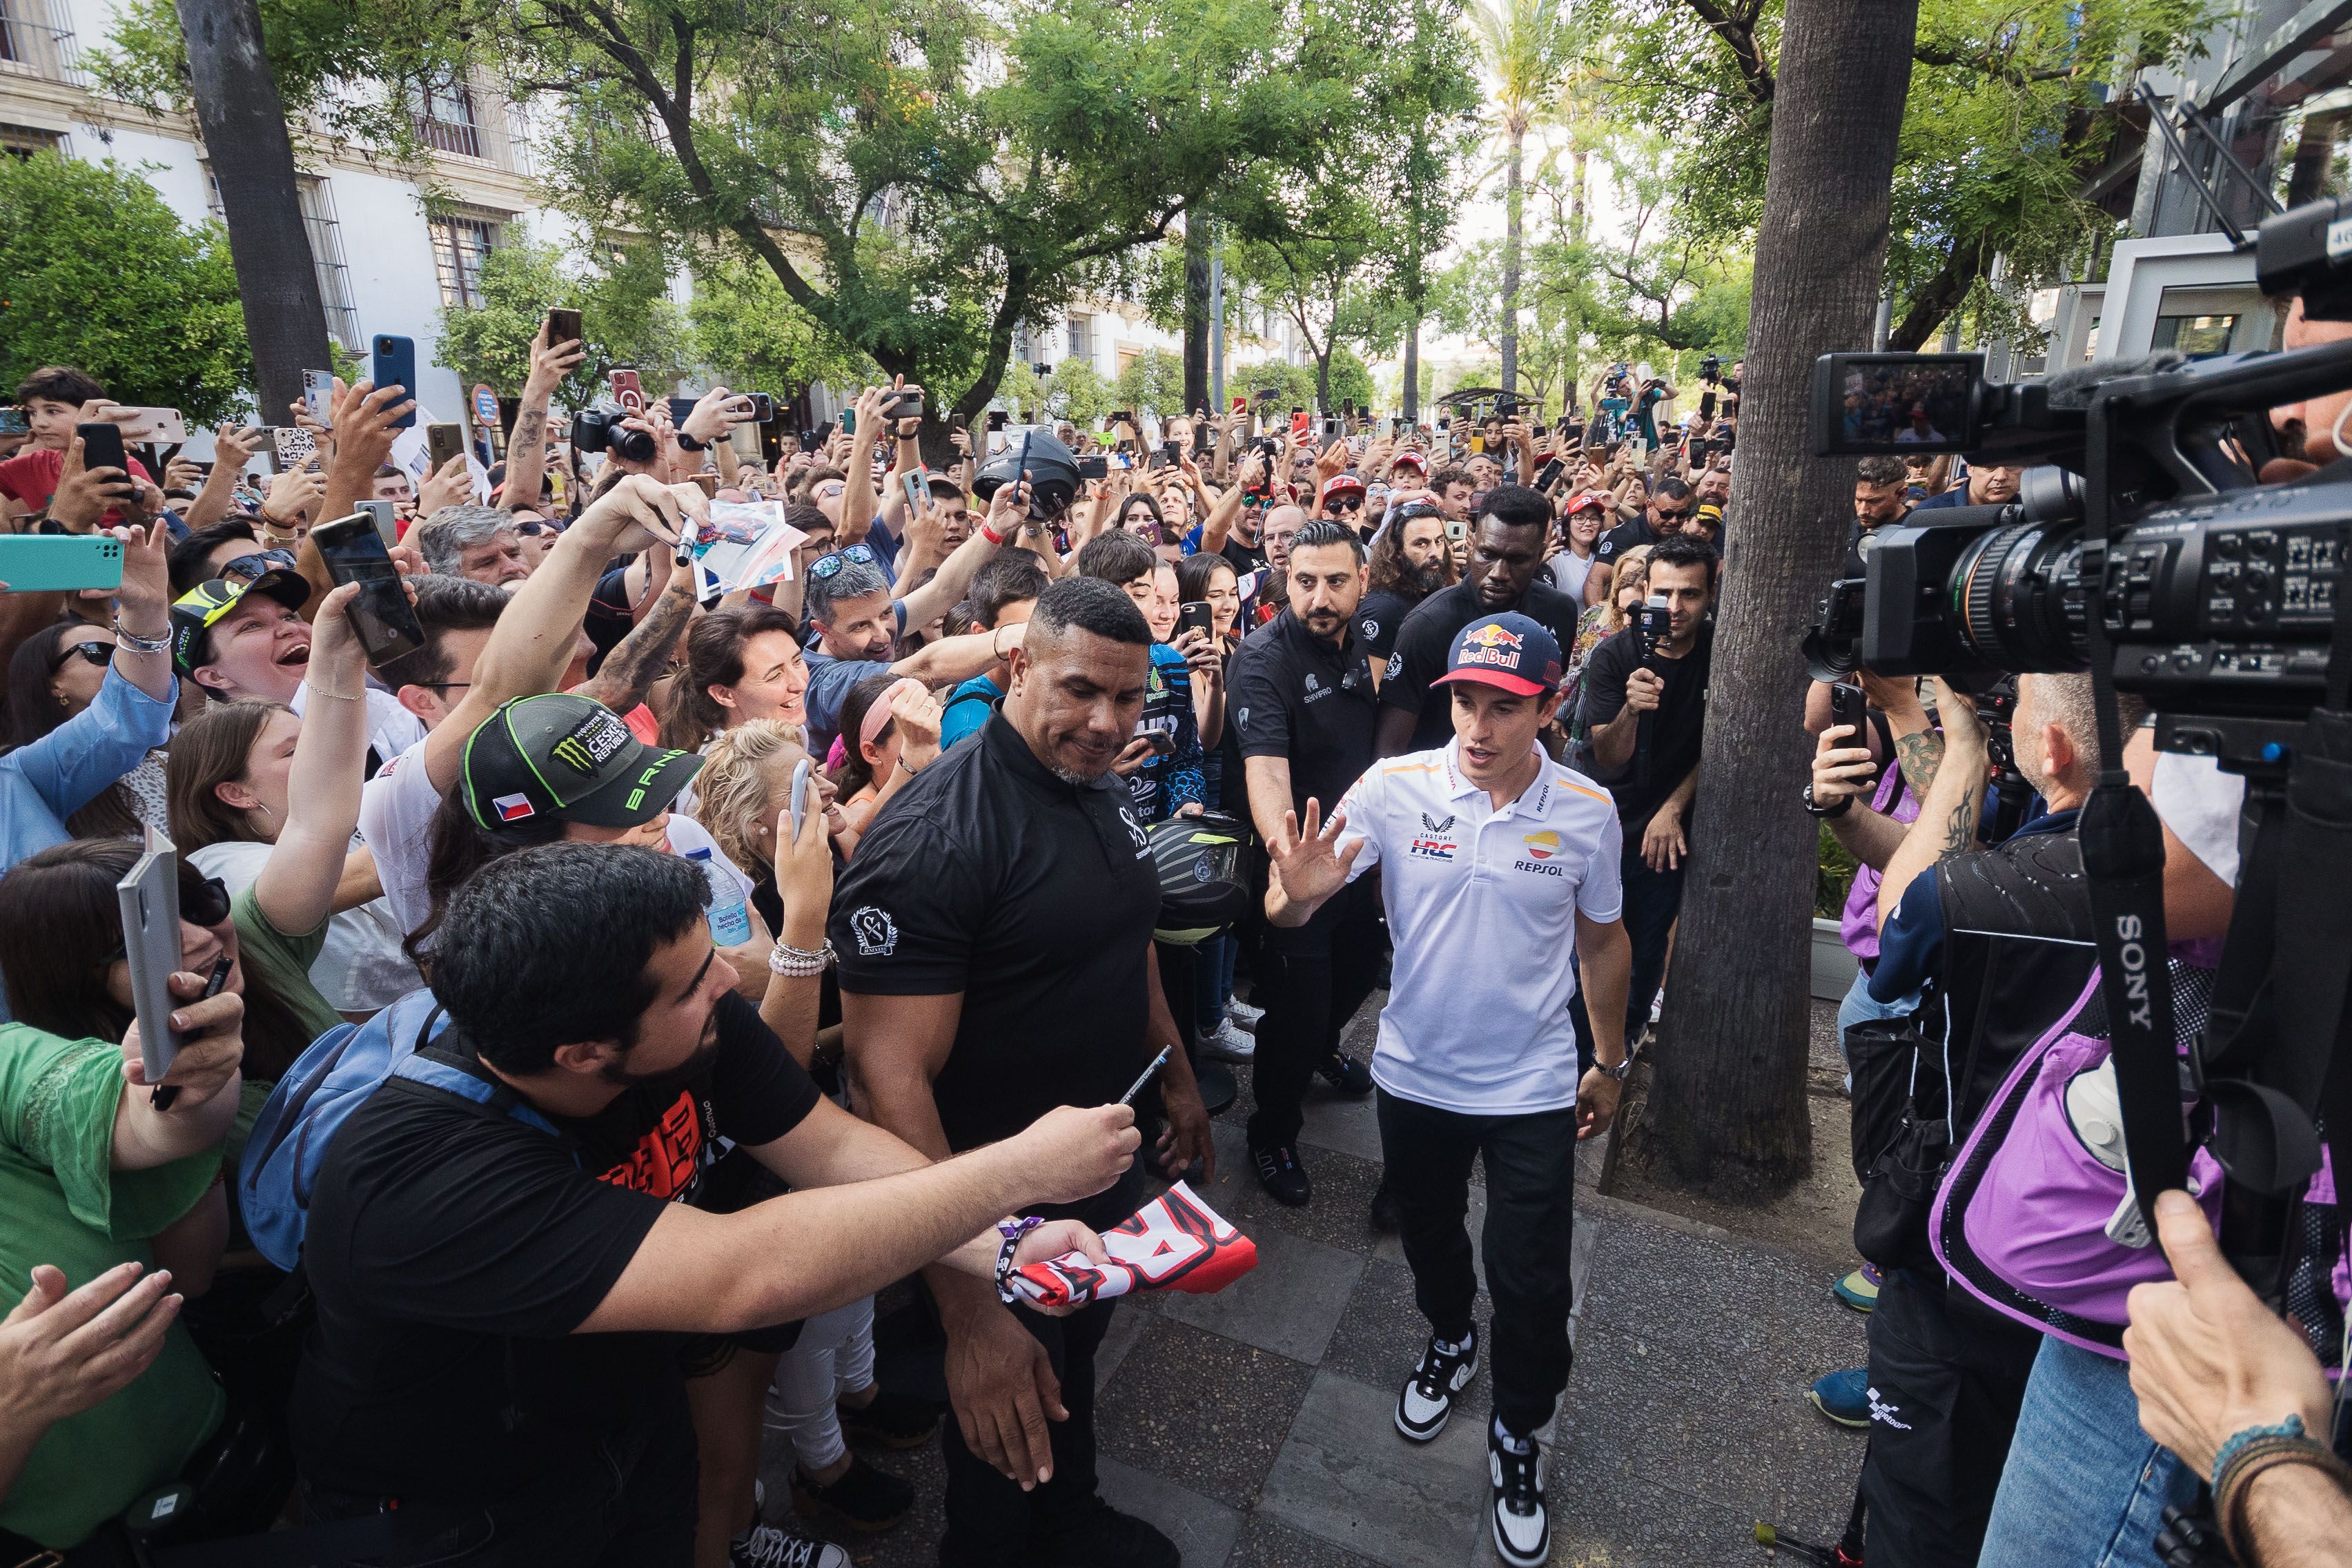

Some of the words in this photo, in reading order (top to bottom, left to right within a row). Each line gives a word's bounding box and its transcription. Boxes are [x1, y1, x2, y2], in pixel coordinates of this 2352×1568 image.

[1458, 647, 1485, 665] Red
[1485, 647, 1520, 669] Bull
[625, 749, 688, 811] BRNO
[1536, 784, 1549, 812] REPSOL
[1513, 860, 1563, 876] REPSOL
[718, 912, 738, 923] Botella
[2117, 914, 2153, 1030] SONY
[703, 1099, 717, 1139] Quechua
